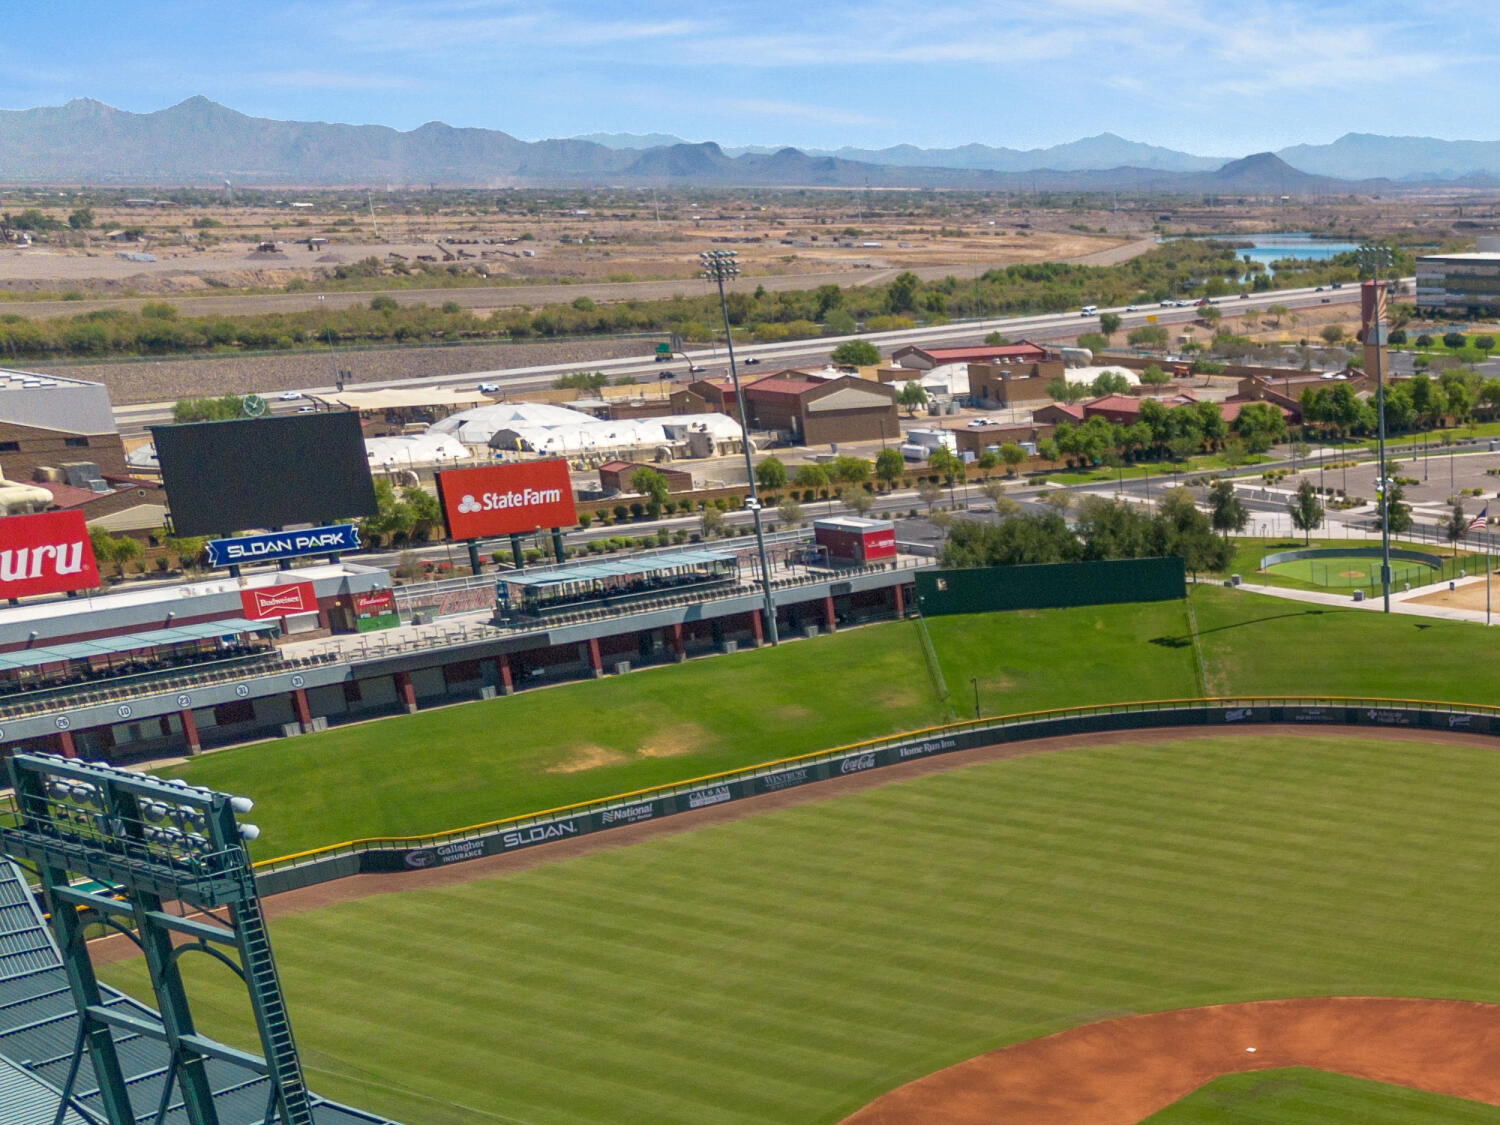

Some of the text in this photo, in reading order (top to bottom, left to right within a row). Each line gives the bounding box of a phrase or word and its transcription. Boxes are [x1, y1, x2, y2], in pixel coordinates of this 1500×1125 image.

[227, 532, 345, 558] SLOAN PARK
[260, 596, 300, 607] Budweiser
[900, 745, 923, 758] Home
[923, 741, 941, 753] Run
[614, 803, 653, 820] National
[503, 821, 577, 848] SLOAN
[437, 840, 485, 856] Gallagher
[443, 849, 483, 864] INSURANCE
